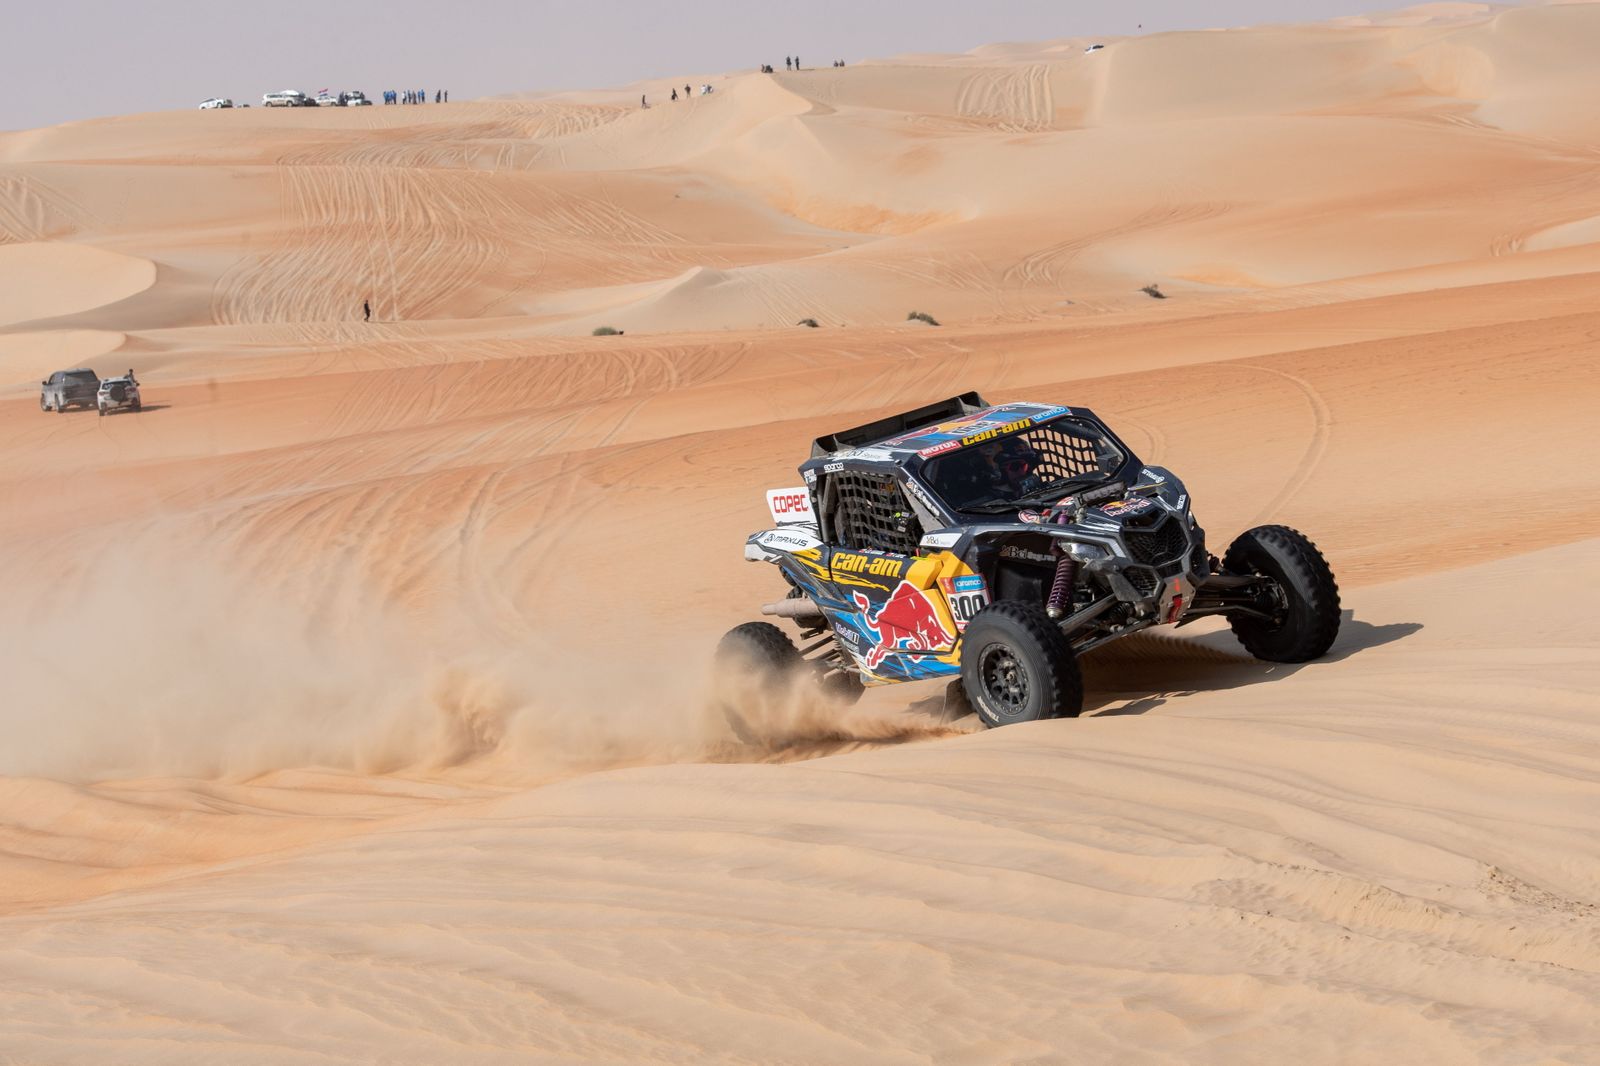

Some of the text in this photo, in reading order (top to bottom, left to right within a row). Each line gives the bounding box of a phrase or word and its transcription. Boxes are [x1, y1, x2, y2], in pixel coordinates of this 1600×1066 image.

[962, 418, 1031, 446] can-am
[922, 441, 957, 457] MOTUL
[823, 462, 845, 473] sparco
[773, 494, 809, 513] COPEC
[774, 535, 809, 547] MAXUS
[831, 552, 904, 578] can-am
[956, 579, 982, 587] aramco
[950, 594, 986, 621] 300
